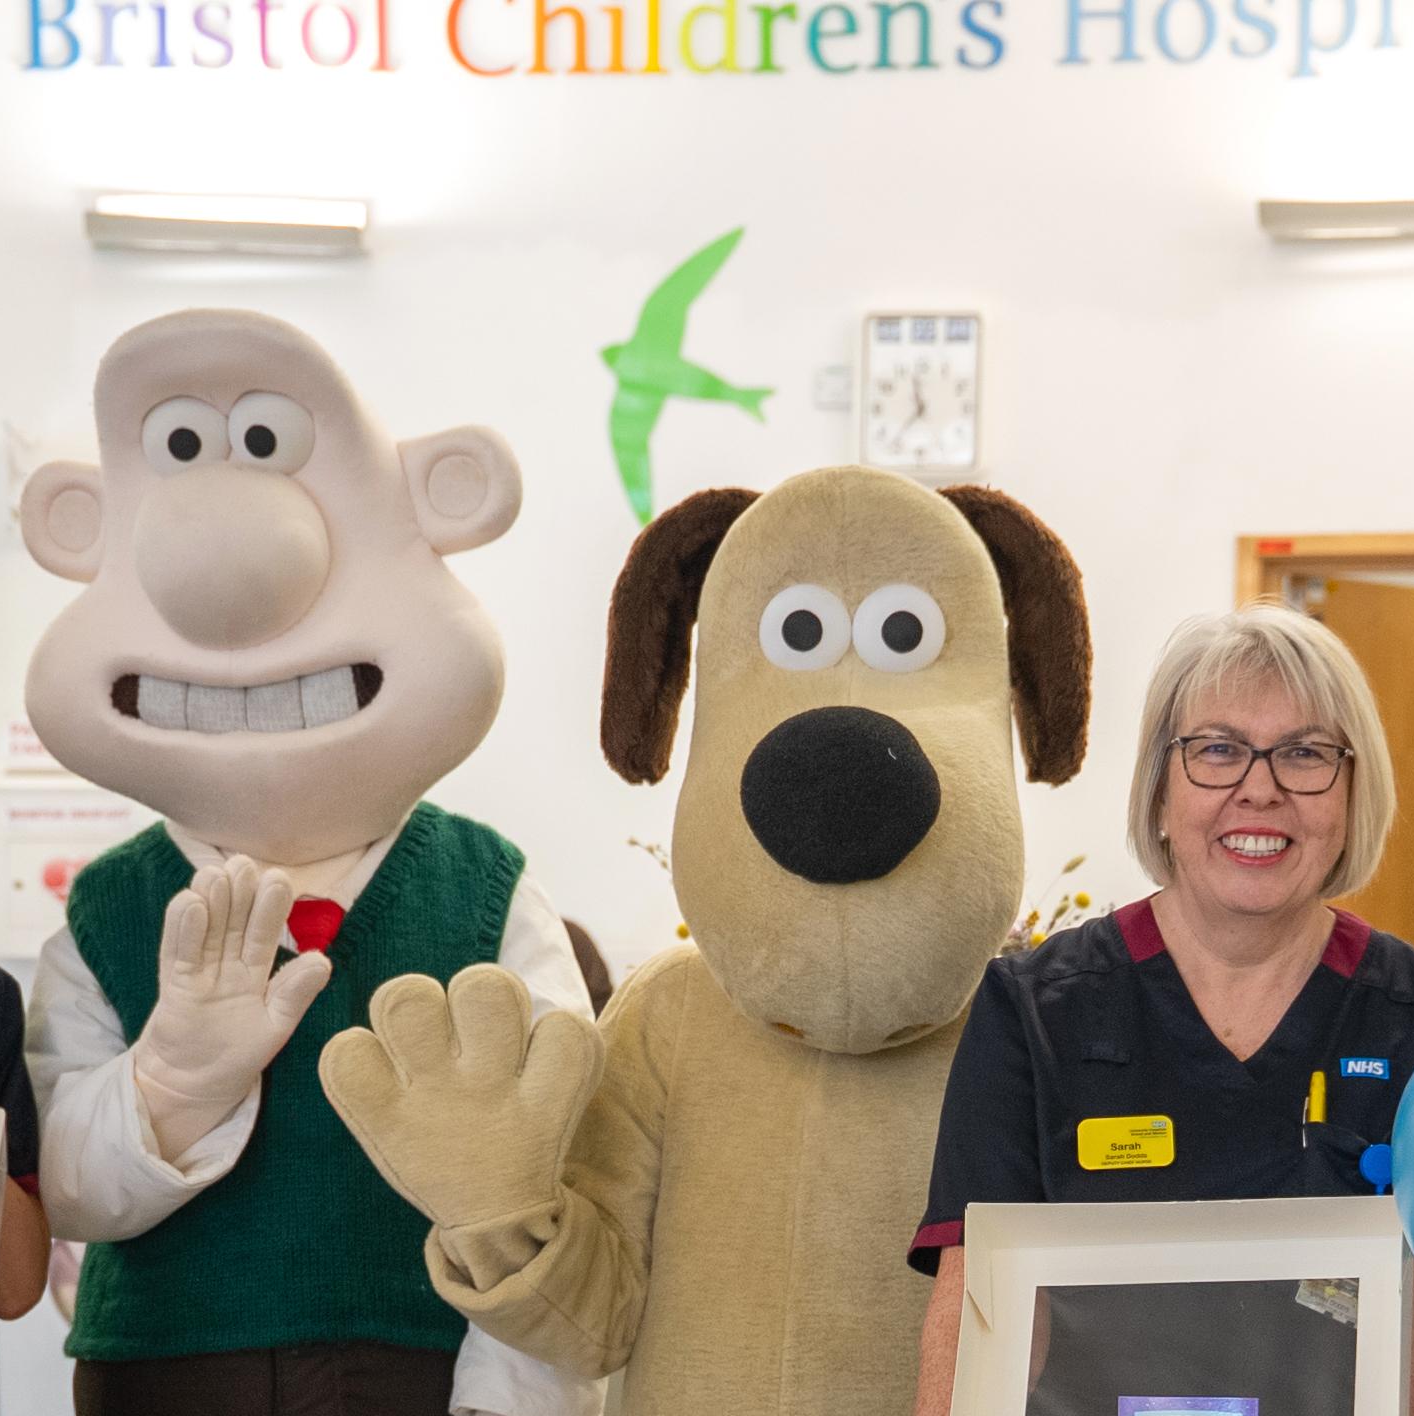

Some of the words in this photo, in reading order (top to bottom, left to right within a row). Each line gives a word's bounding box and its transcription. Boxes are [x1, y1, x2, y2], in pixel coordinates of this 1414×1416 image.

[21, 0, 397, 71] Bristol
[1347, 1060, 1384, 1075] NHS
[1110, 1142, 1141, 1151] Sarah
